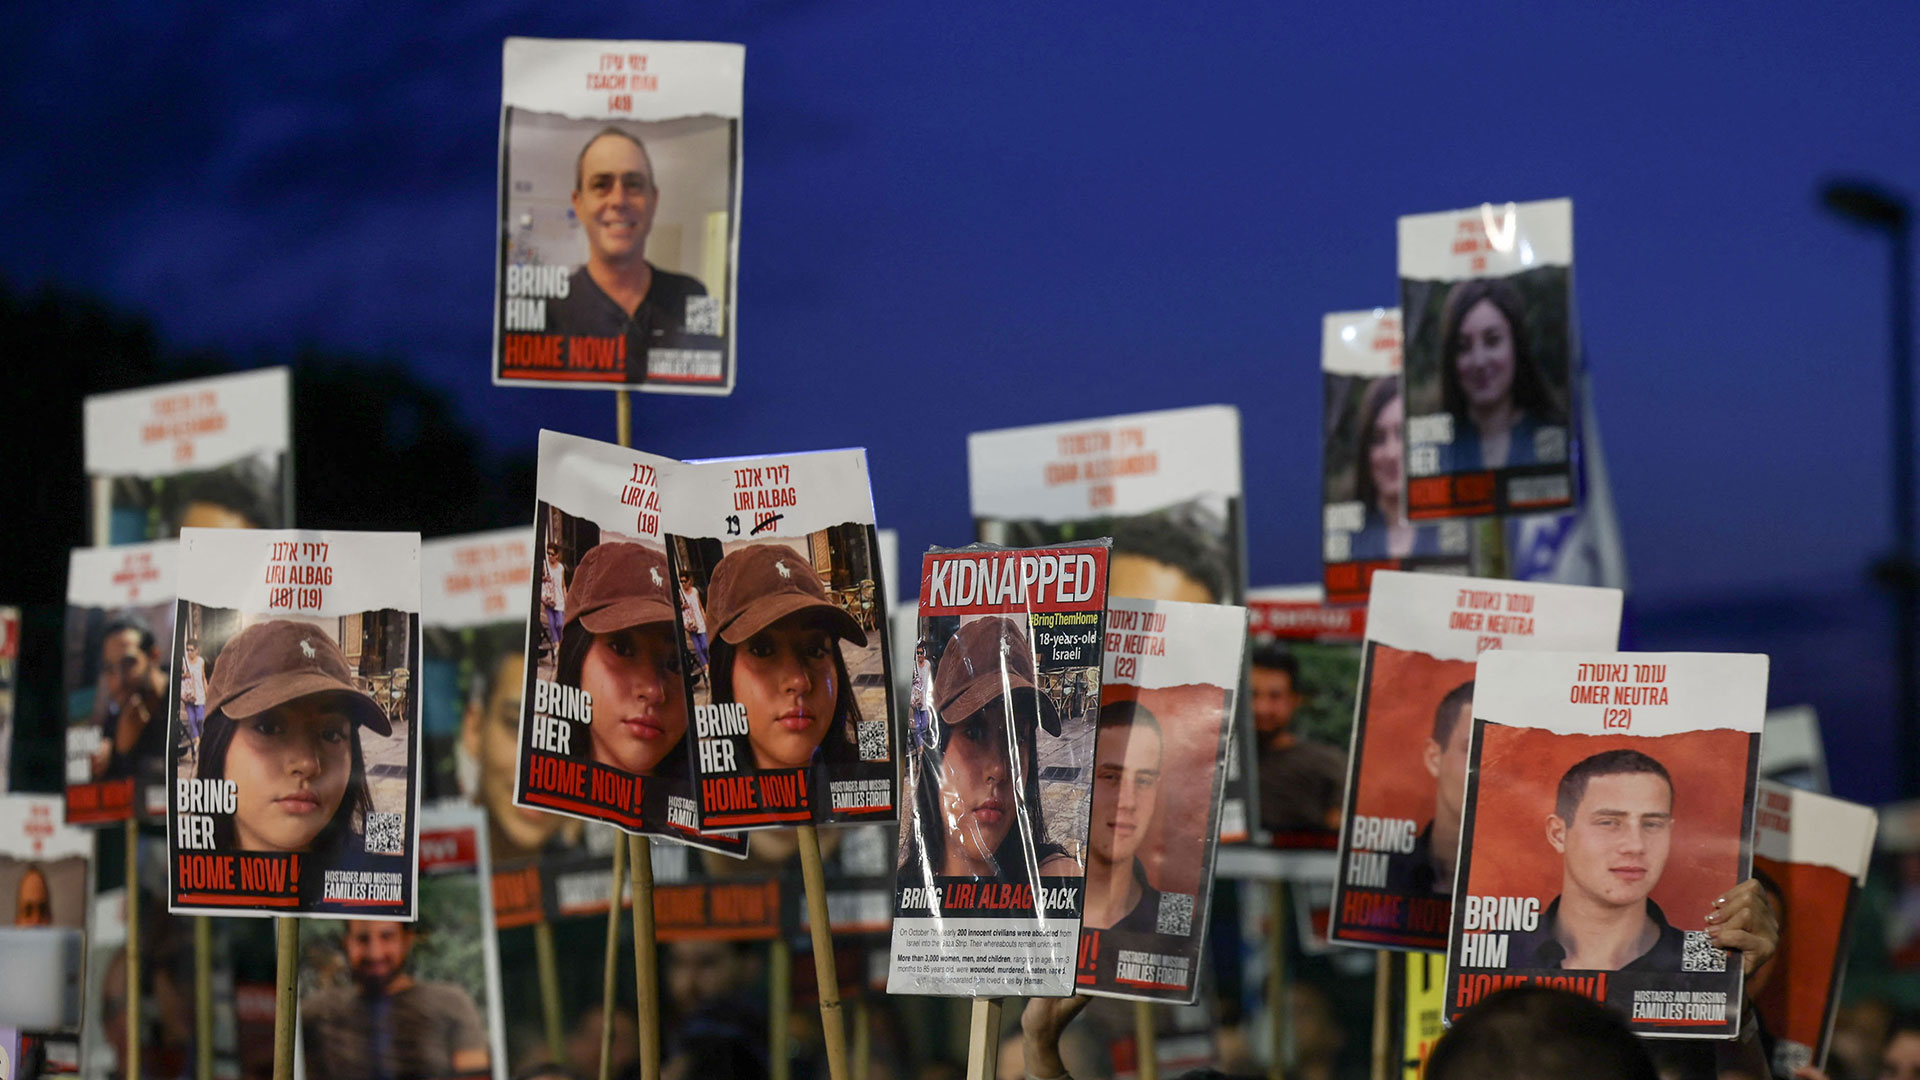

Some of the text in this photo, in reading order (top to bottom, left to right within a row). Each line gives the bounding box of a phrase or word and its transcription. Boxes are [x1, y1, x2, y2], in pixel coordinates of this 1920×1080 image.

[507, 265, 570, 299] BRING
[504, 299, 546, 331] HIM
[504, 334, 564, 367] HOME
[568, 332, 626, 370] NOW!
[620, 485, 662, 513] LIRI AL
[733, 487, 797, 511] LIRI ALBAG
[637, 511, 659, 538] (18)
[265, 565, 332, 585] LIRI ALBAG
[929, 554, 1097, 608] KIDNAPPED
[297, 587, 322, 610] (19)
[1030, 612, 1098, 630] #BringThemHome
[1039, 630, 1098, 650] 18-years-old
[1123, 634, 1165, 657] NEUTRA
[1052, 647, 1081, 661] Israeli
[1114, 655, 1136, 681] (22)
[534, 679, 592, 725] BRING
[1570, 685, 1668, 706] OMER NEUTRA
[694, 702, 749, 738] BRING
[1603, 707, 1632, 730] (22)
[532, 715, 572, 755] HER
[698, 738, 738, 774] HER
[177, 778, 237, 814] BRING
[529, 754, 643, 815] HOME NOW!
[702, 769, 809, 812] HOME NOW!
[832, 790, 890, 809] FAMILIES FORUM
[177, 814, 216, 850] HER
[1351, 815, 1417, 855] BRING
[179, 854, 299, 893] HOME NOW!
[325, 870, 402, 885] HOSTAGES AND MISSING
[1346, 851, 1390, 888] HIM
[324, 882, 402, 902] FAMILIES FORUM
[944, 883, 976, 909] LIRI
[977, 883, 1033, 909] ALBAG
[1342, 891, 1403, 929] HOME
[1463, 896, 1540, 932] BRING
[900, 928, 907, 936] On
[908, 928, 929, 937] October
[968, 928, 992, 937] innocent
[897, 954, 911, 962] More
[912, 954, 924, 962] than
[925, 954, 939, 963] 3,000
[976, 955, 987, 963] and
[1460, 933, 1509, 968] HIM
[1016, 976, 1023, 986] by
[1117, 962, 1189, 986] FAMILIES FORUM
[1634, 990, 1727, 1004] HOSTAGES AND MISSING
[1633, 1002, 1726, 1021] FAMILIES FORUM
